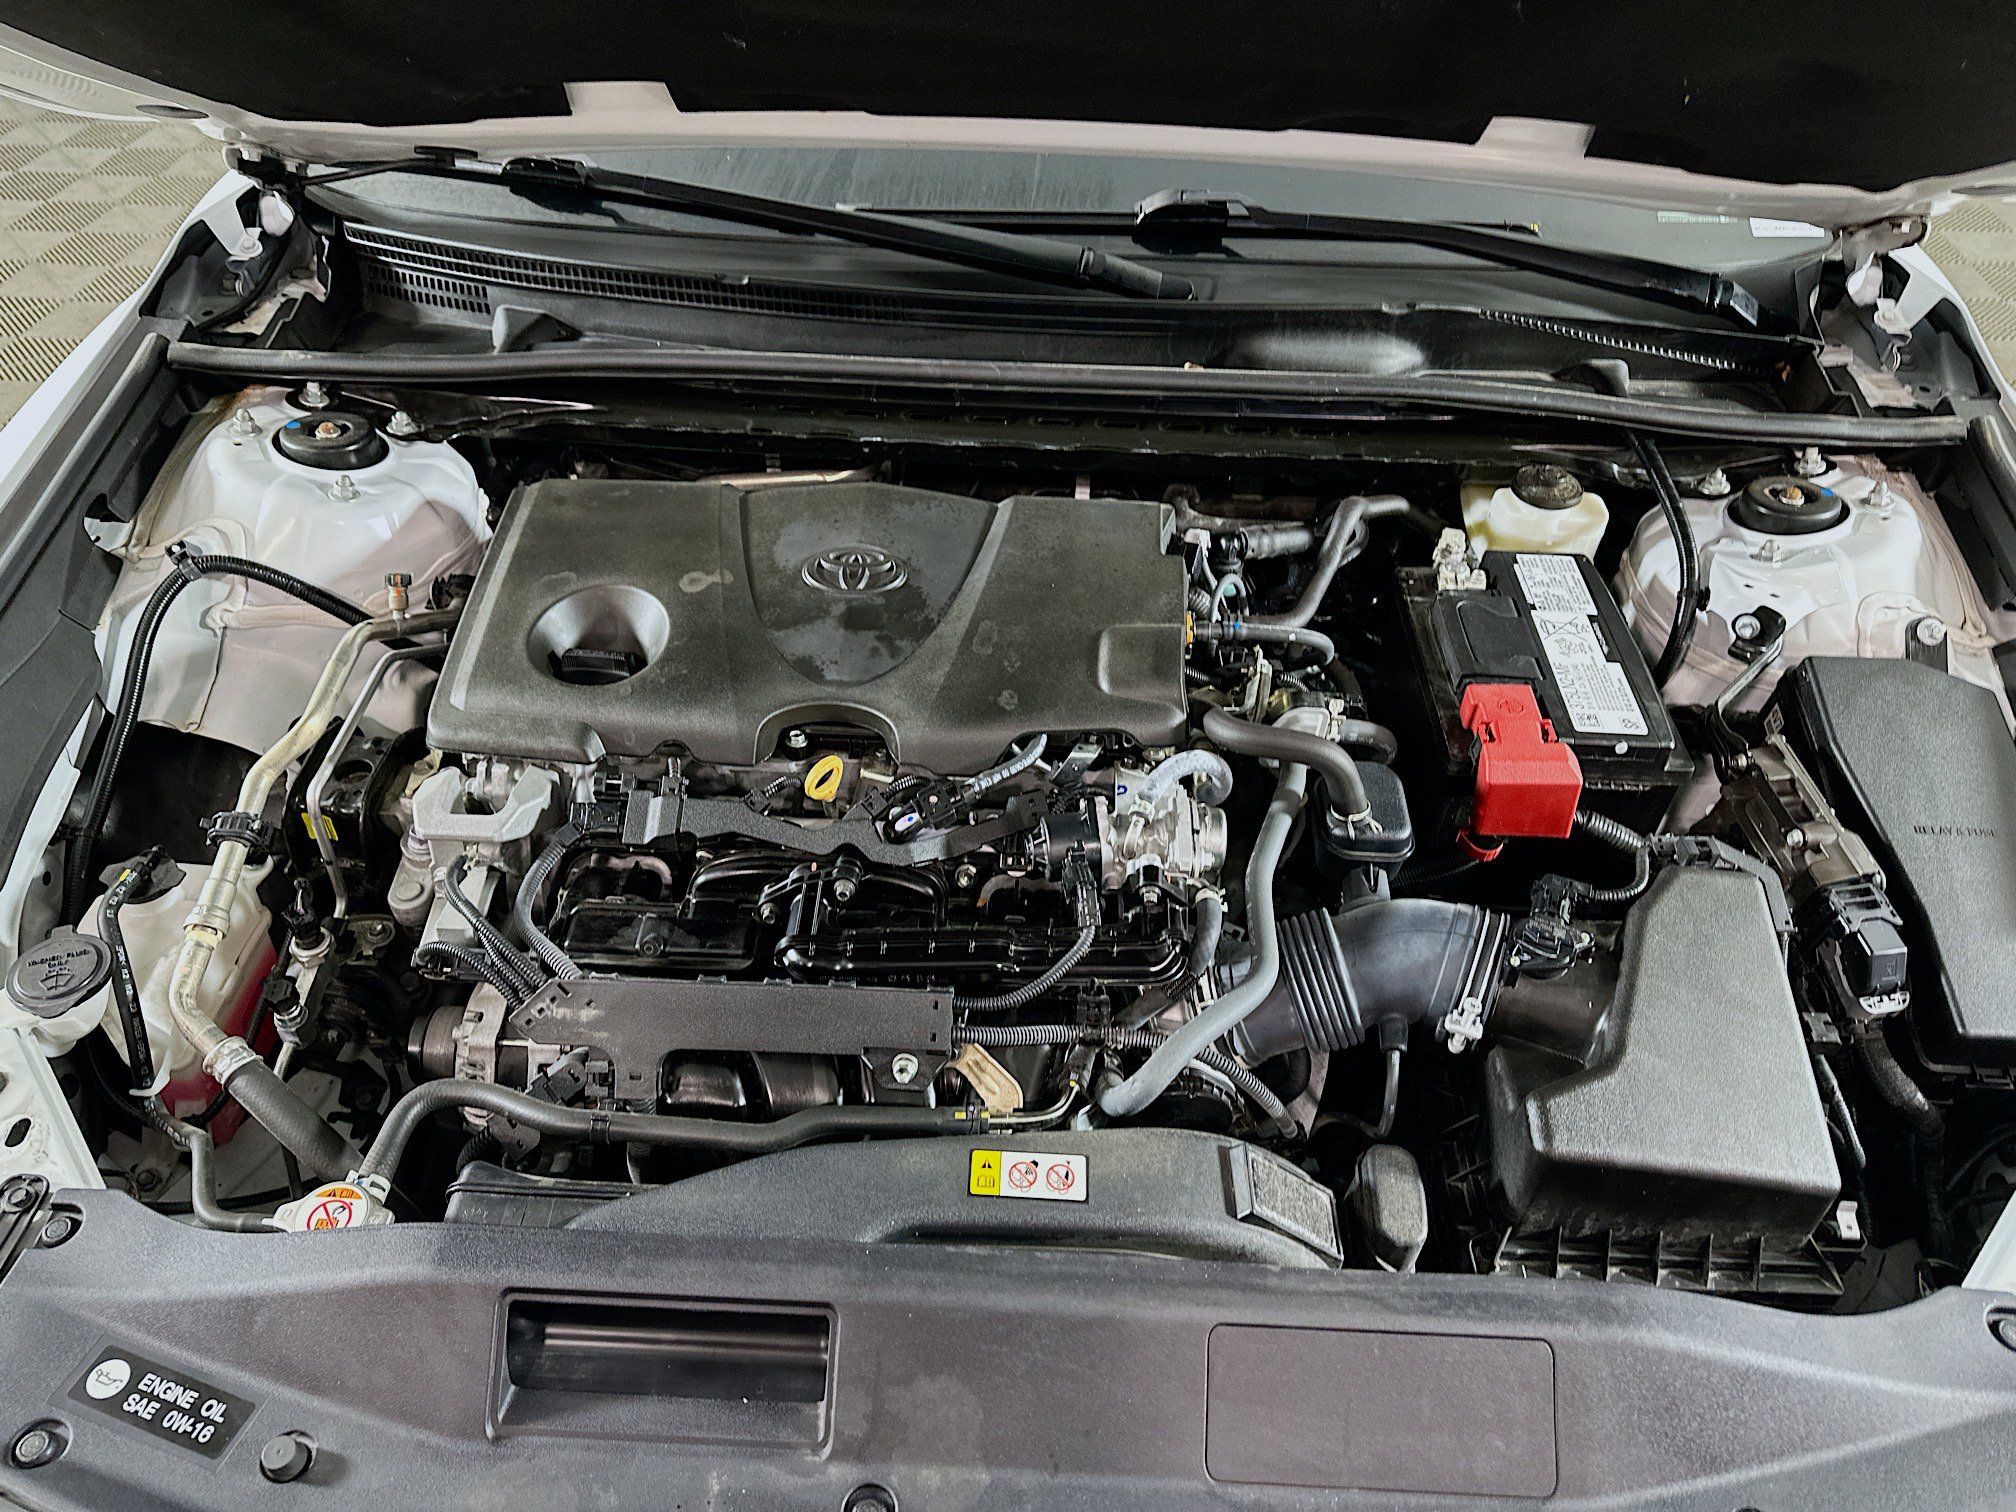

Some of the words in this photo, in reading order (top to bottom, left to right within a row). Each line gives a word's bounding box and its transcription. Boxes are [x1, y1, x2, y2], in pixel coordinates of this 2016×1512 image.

[122, 1393, 161, 1421] SAE
[162, 1409, 216, 1444] 0W-16
[137, 1372, 200, 1410] ENGINE
[200, 1398, 227, 1424] OIL
